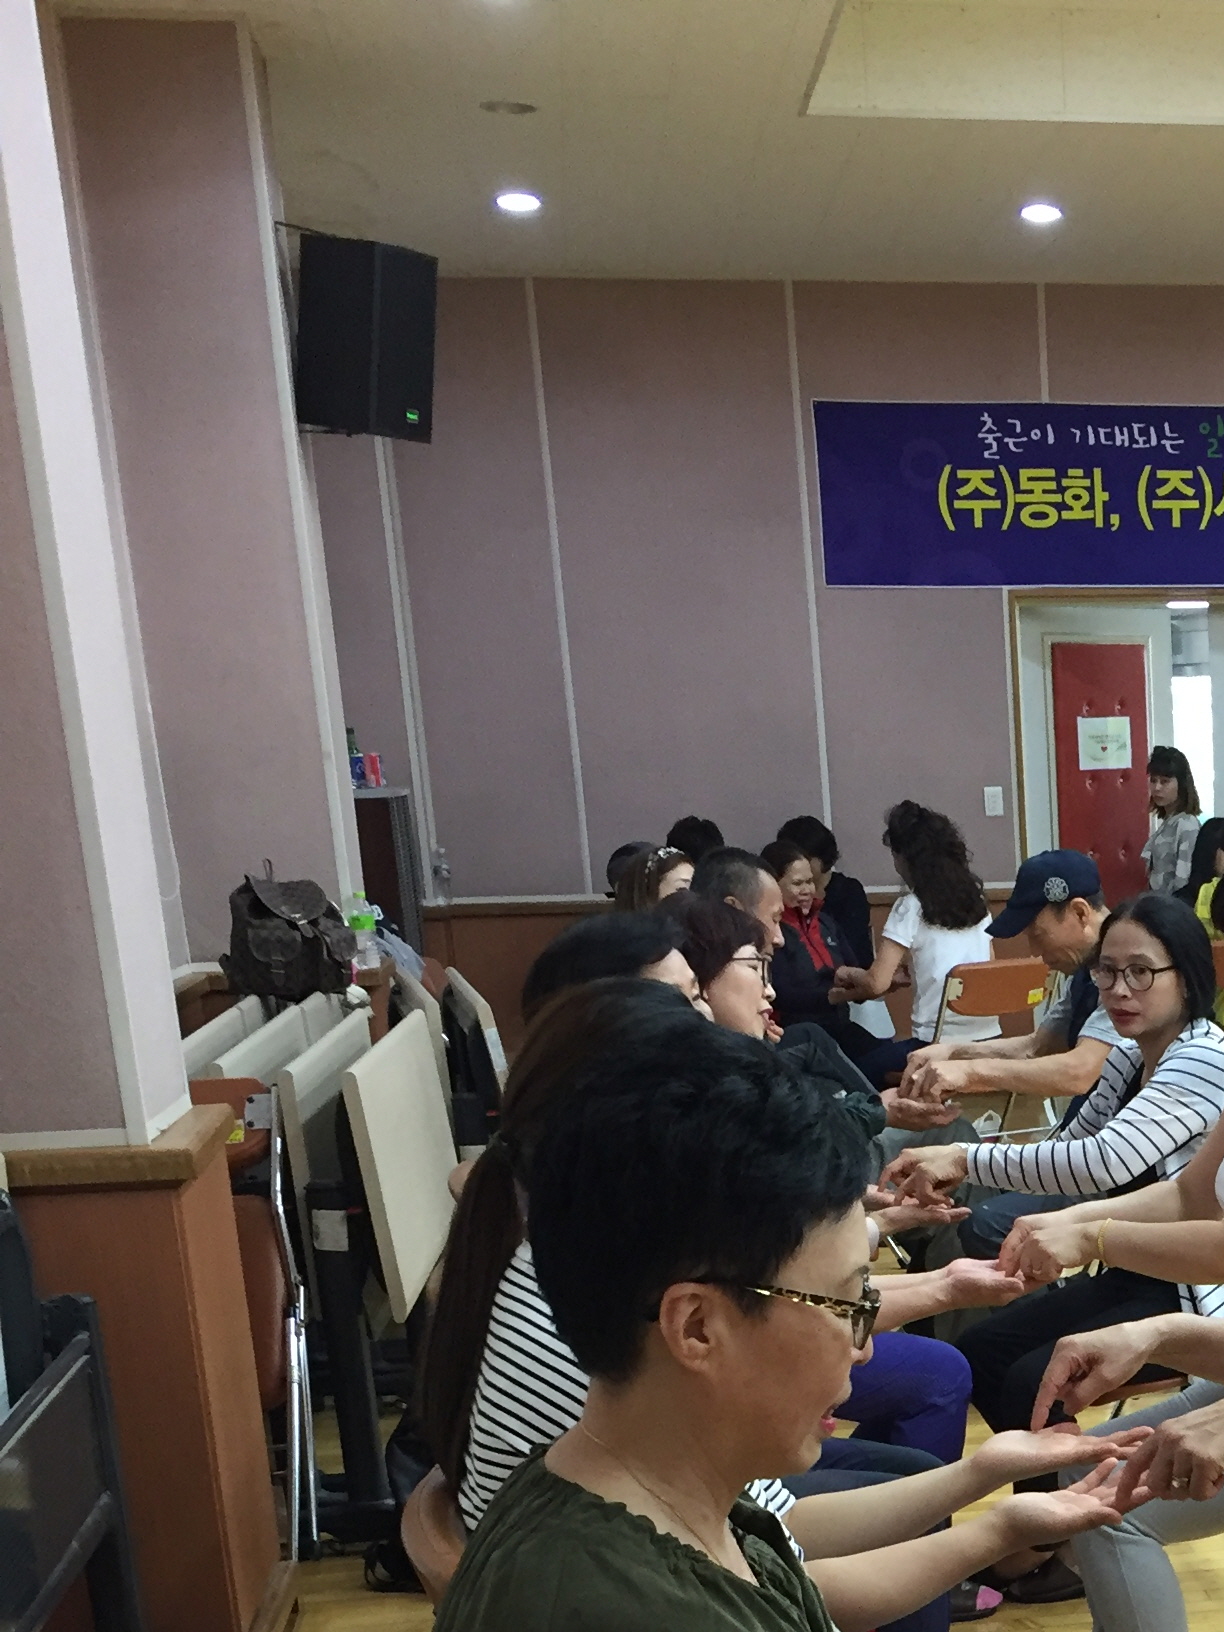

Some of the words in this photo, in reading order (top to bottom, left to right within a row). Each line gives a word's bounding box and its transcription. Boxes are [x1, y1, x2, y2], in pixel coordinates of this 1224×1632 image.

[977, 412, 1055, 459] 출근이
[1070, 421, 1185, 454] 기대되는
[938, 464, 1120, 531] (주)동화,
